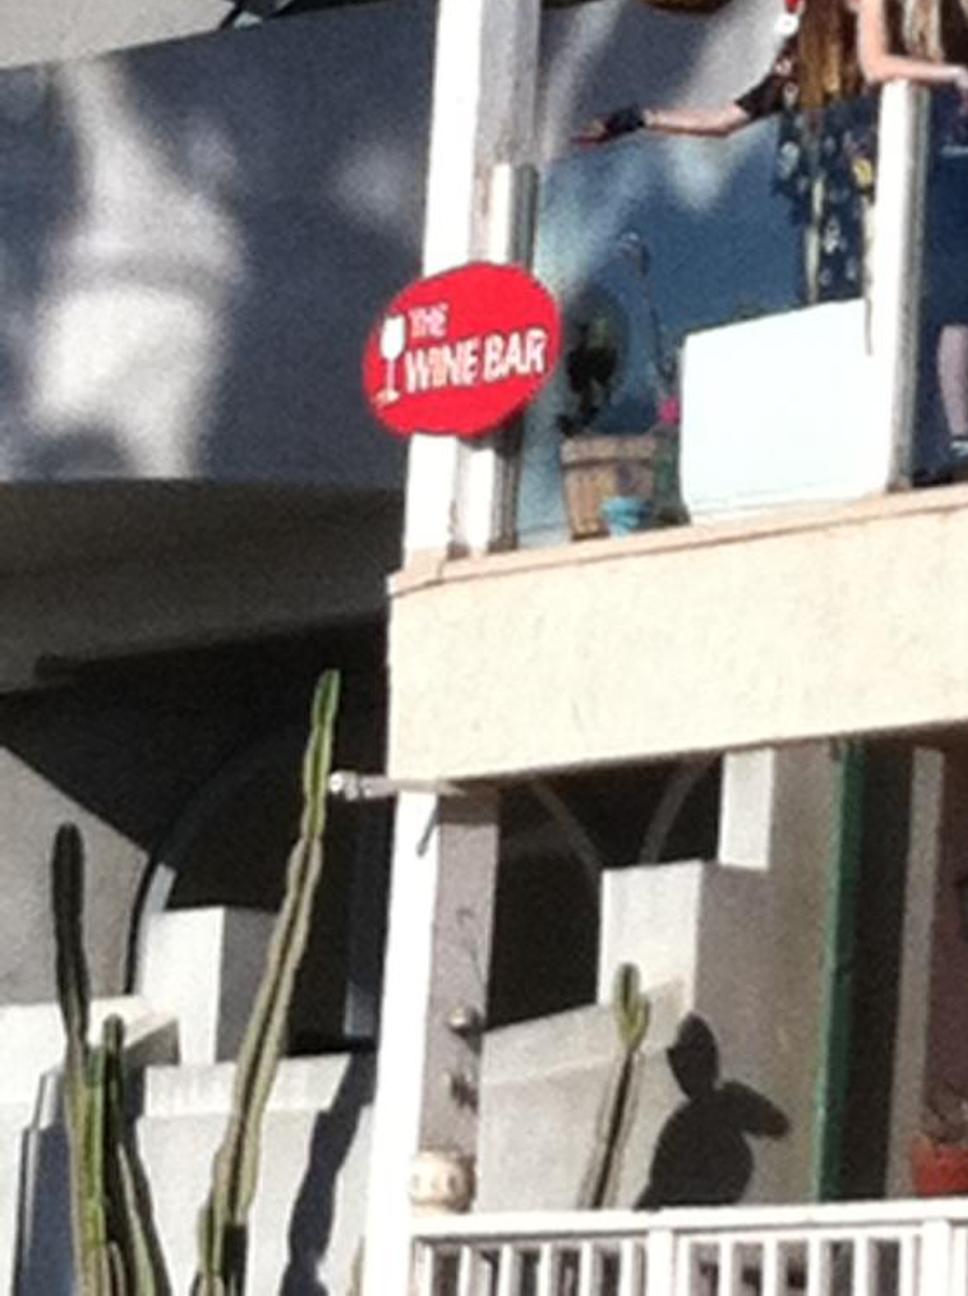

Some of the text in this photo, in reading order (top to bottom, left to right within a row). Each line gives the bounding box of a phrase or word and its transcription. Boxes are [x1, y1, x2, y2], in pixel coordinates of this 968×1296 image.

[408, 303, 448, 339] THE
[405, 328, 547, 392] WINE BAR
